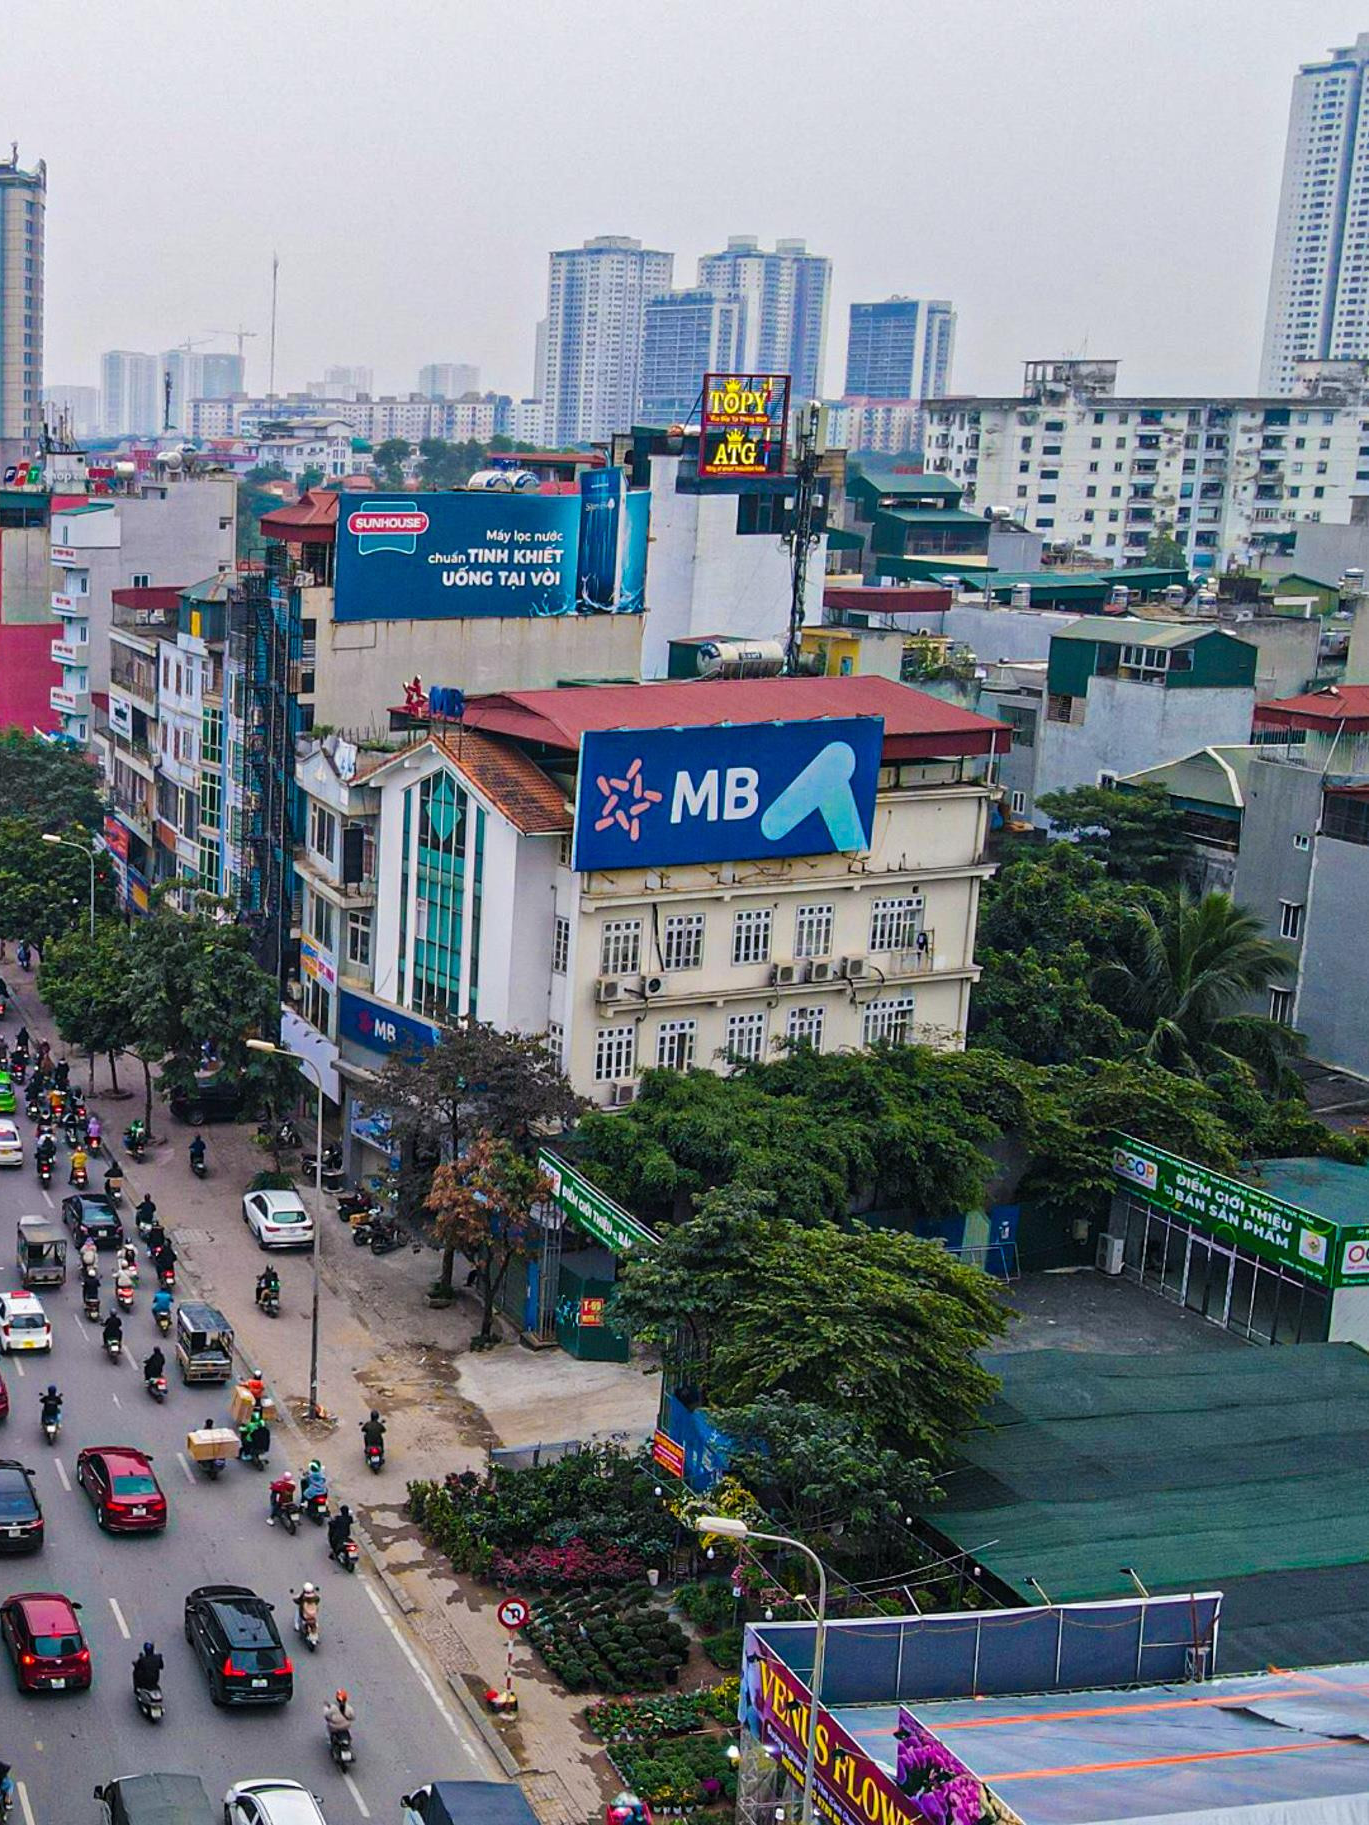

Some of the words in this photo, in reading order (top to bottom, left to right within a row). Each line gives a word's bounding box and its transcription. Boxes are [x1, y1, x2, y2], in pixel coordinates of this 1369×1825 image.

[709, 390, 768, 414] TOPY
[713, 442, 757, 465] ATG
[5, 464, 40, 482] FPT
[355, 517, 422, 529] SUNHOUSE
[486, 530, 510, 544] Máy
[514, 530, 531, 544] lọc
[534, 530, 563, 542] nước
[468, 548, 508, 563] TINH
[513, 544, 564, 563] KHIẾT
[442, 564, 493, 586] UỐNG
[497, 571, 525, 590] TẠI
[530, 566, 560, 586] VÒI
[670, 767, 759, 824] MB
[374, 1018, 397, 1043] MB
[1176, 1173, 1211, 1198] ĐIỂM
[1214, 1190, 1245, 1212] GIỚI
[1248, 1204, 1292, 1233] THIỆU
[1175, 1190, 1205, 1212] BÁN
[1208, 1204, 1240, 1227] SẢN
[1243, 1219, 1289, 1249] PHẨM
[759, 1658, 829, 1766] VENUS
